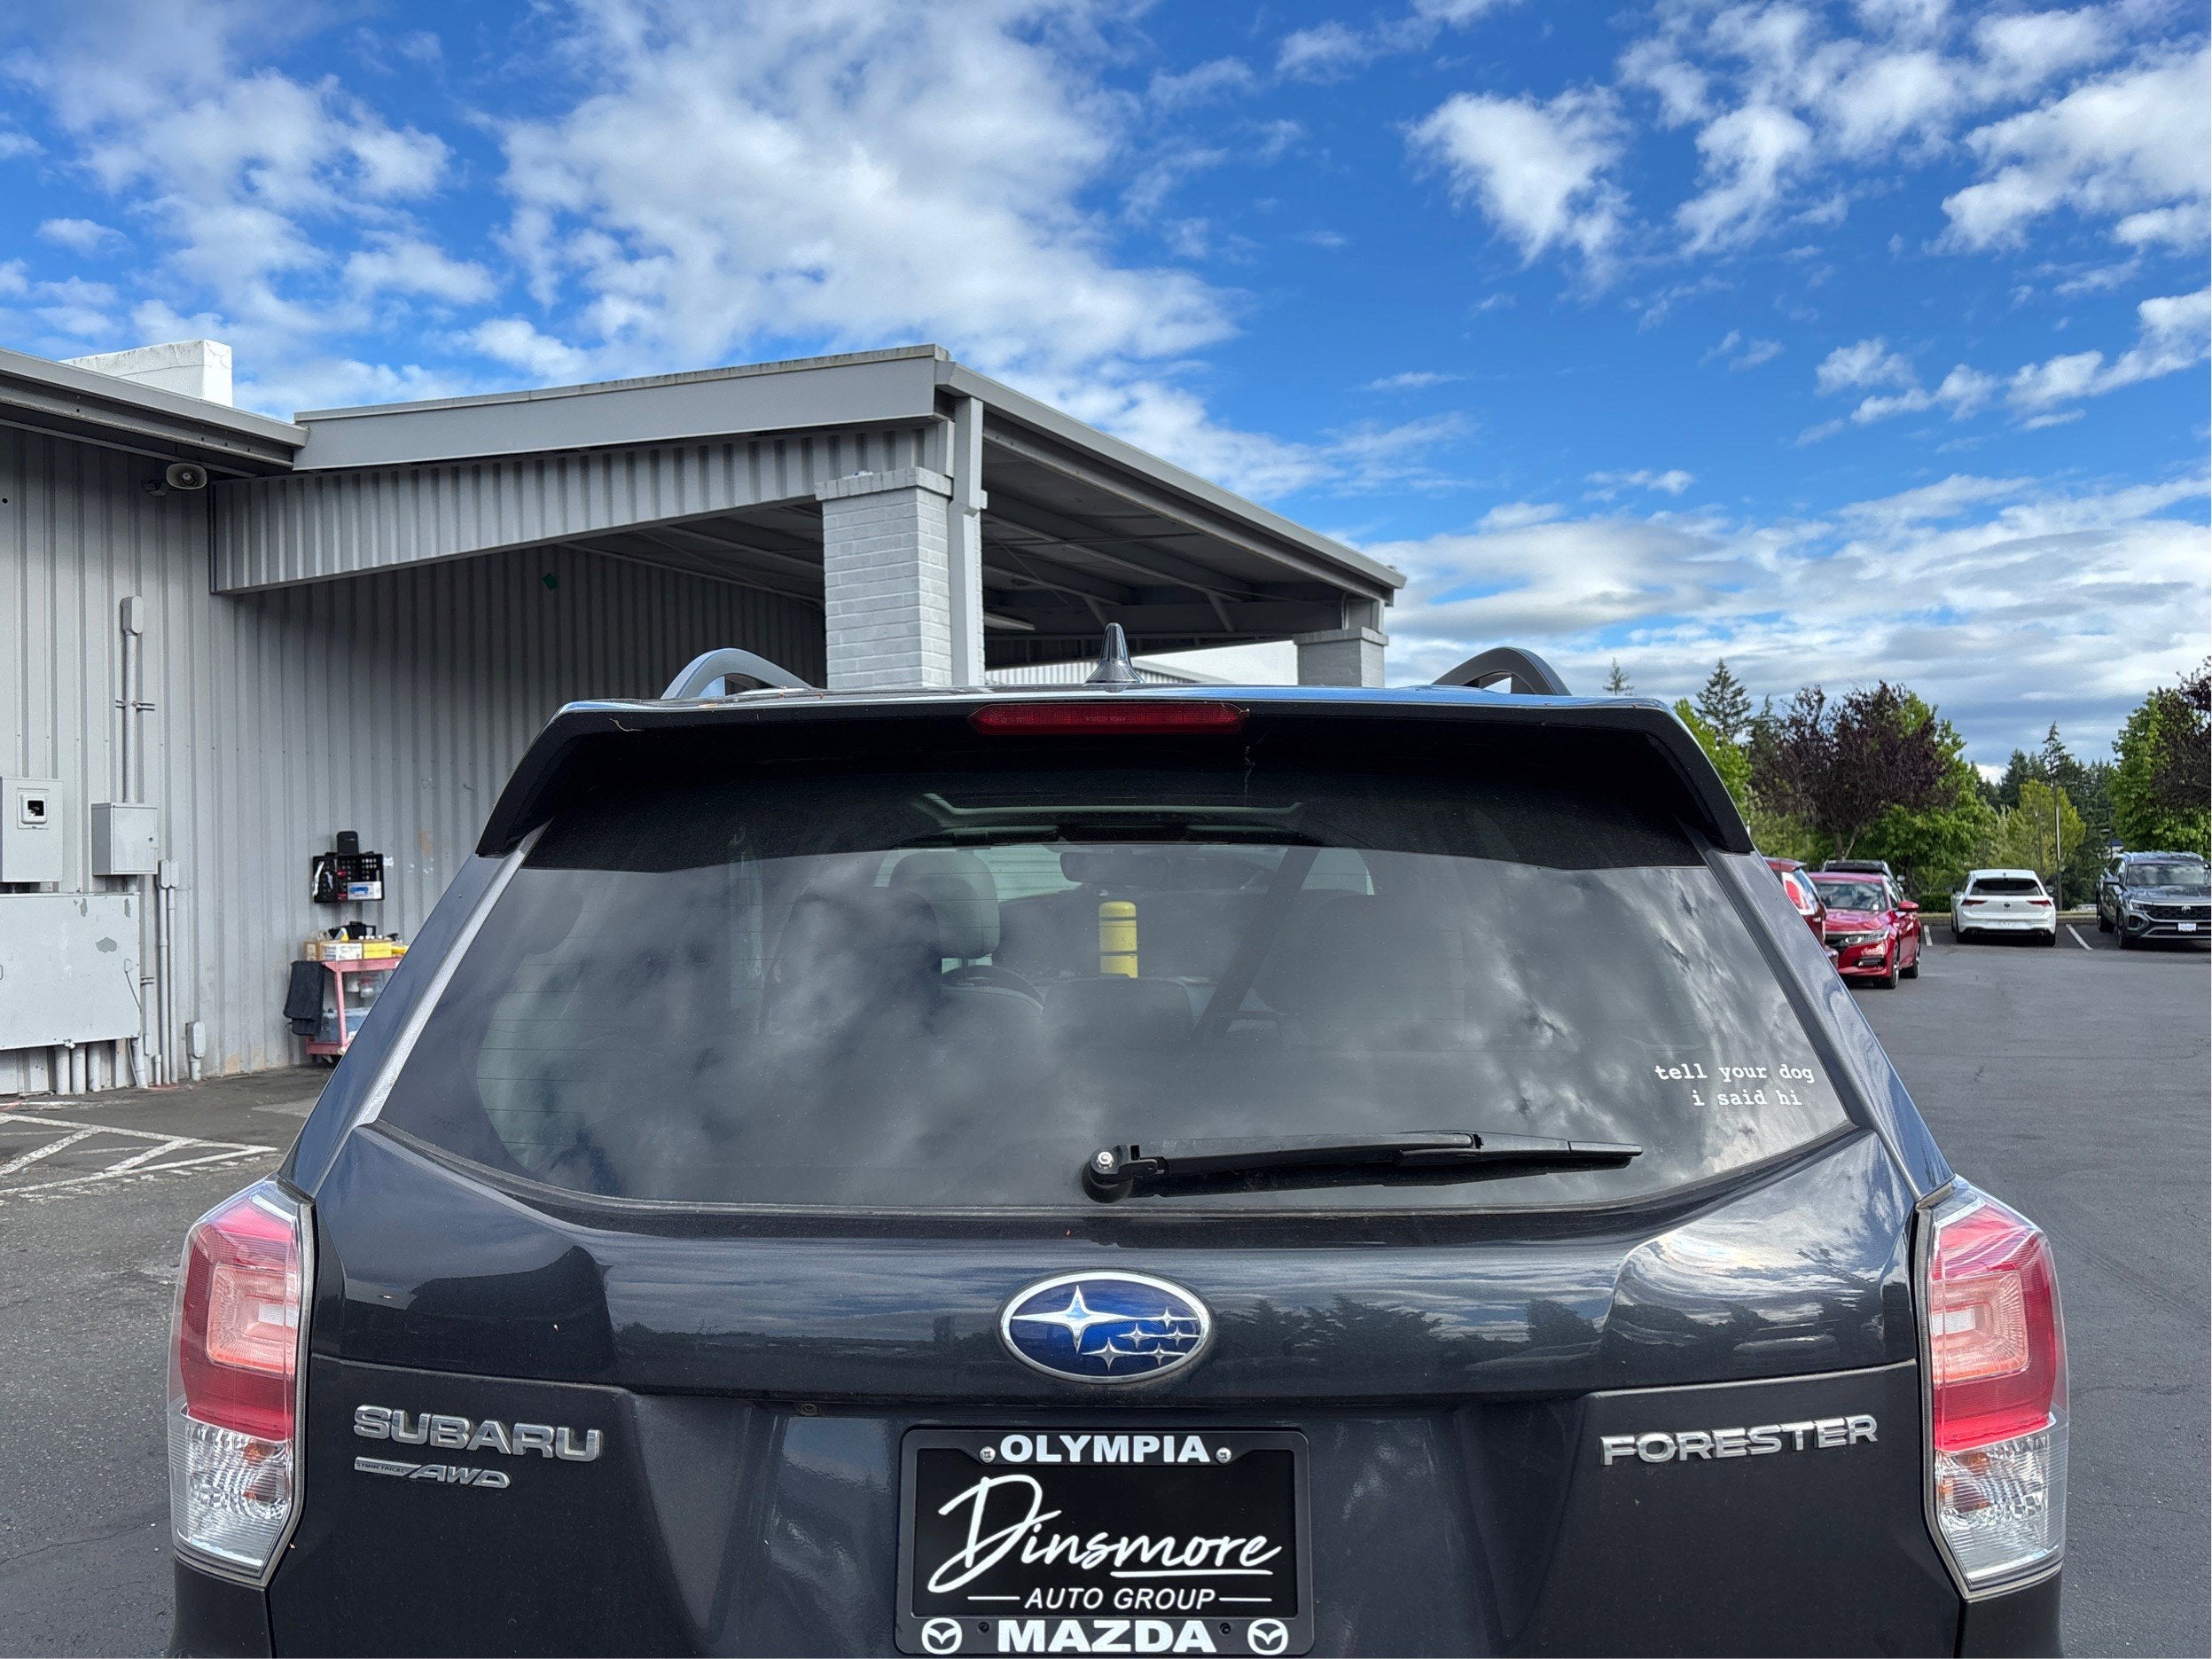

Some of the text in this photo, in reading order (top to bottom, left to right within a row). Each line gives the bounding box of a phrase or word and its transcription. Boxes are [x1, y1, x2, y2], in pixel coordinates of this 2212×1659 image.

[1654, 1063, 1815, 1084] tell your dog
[1692, 1089, 1802, 1107] i said hi
[353, 1405, 602, 1463] SUBARU
[1000, 1434, 1210, 1463] OLYMPIA
[1599, 1414, 1878, 1466] FORESTER
[356, 1462, 511, 1489] SYMMETRICAL AWD
[927, 1474, 1282, 1593] Dinsmore
[1024, 1587, 1216, 1610] AUTO GROUP
[997, 1619, 1217, 1654] MAZDA
